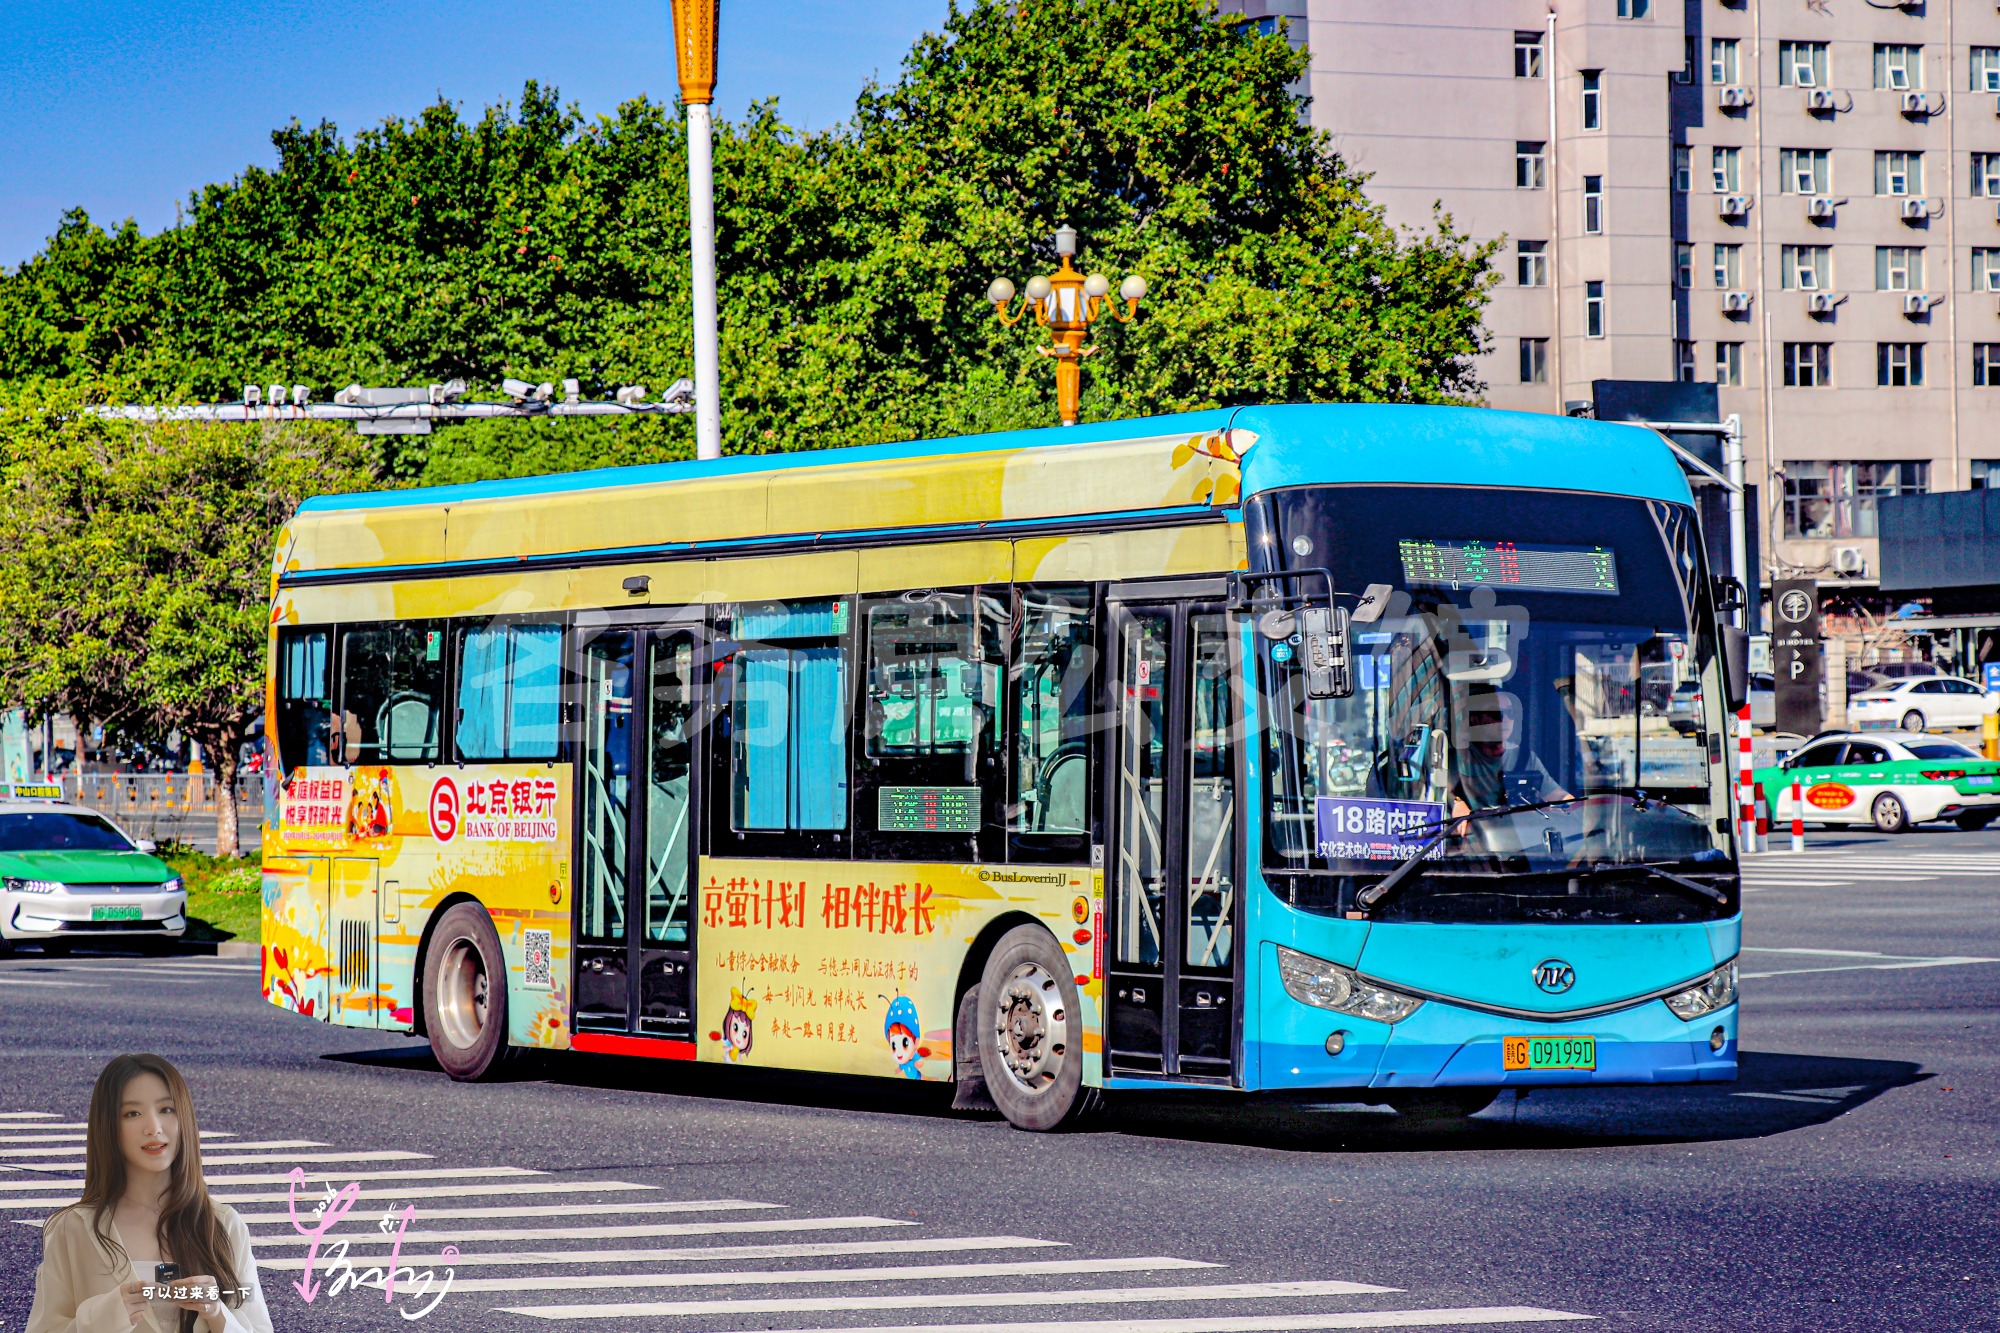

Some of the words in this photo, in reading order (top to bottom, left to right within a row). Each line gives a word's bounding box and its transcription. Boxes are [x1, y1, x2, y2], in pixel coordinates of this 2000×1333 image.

[1790, 660, 1805, 680] P
[286, 780, 342, 801] 家庭权益日
[467, 779, 556, 817] 北京银行
[286, 805, 342, 826] 悦享好时光
[1332, 805, 1428, 836] 18路内环
[466, 822, 495, 837] BANK
[497, 822, 511, 837] OF
[514, 822, 556, 839] BEIJING
[1320, 841, 1370, 859] 文化艺术中心
[1392, 844, 1441, 860] 文化艺心
[703, 876, 806, 929] 京萤计划
[821, 881, 935, 935] 相伴成长
[715, 950, 800, 974] 儿童综合金融服务
[818, 957, 919, 982] 与您共同见证孩子的
[762, 984, 817, 1007] 每一刻闪光
[823, 989, 868, 1011] 相伴成长
[771, 1017, 858, 1044] 奔赴一路日月星光
